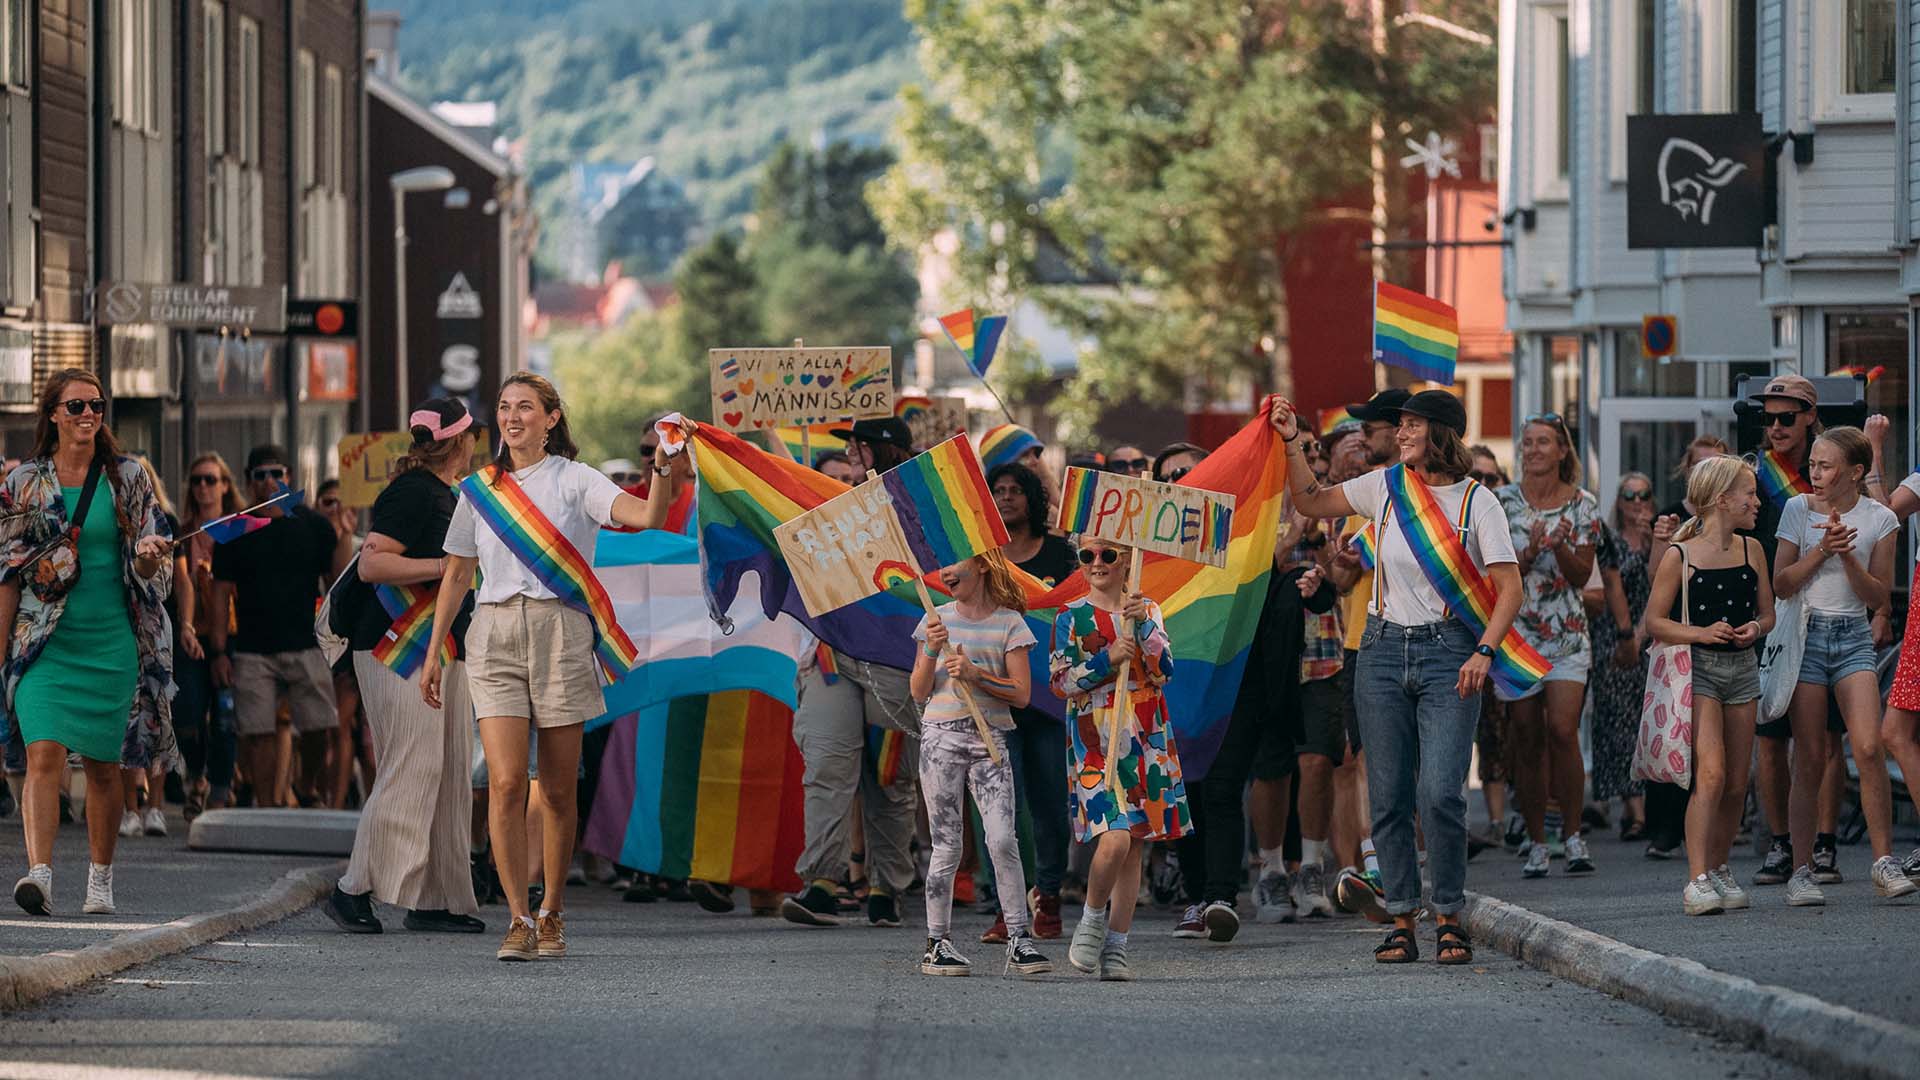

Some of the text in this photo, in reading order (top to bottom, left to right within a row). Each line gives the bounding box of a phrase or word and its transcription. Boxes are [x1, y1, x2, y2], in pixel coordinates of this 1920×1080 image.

[151, 288, 230, 304] STELLAR
[150, 305, 257, 323] EQUIPMENT
[745, 358, 761, 371] VI
[752, 387, 889, 413] MÄNNISKOR
[1094, 488, 1201, 545] PRIDE
